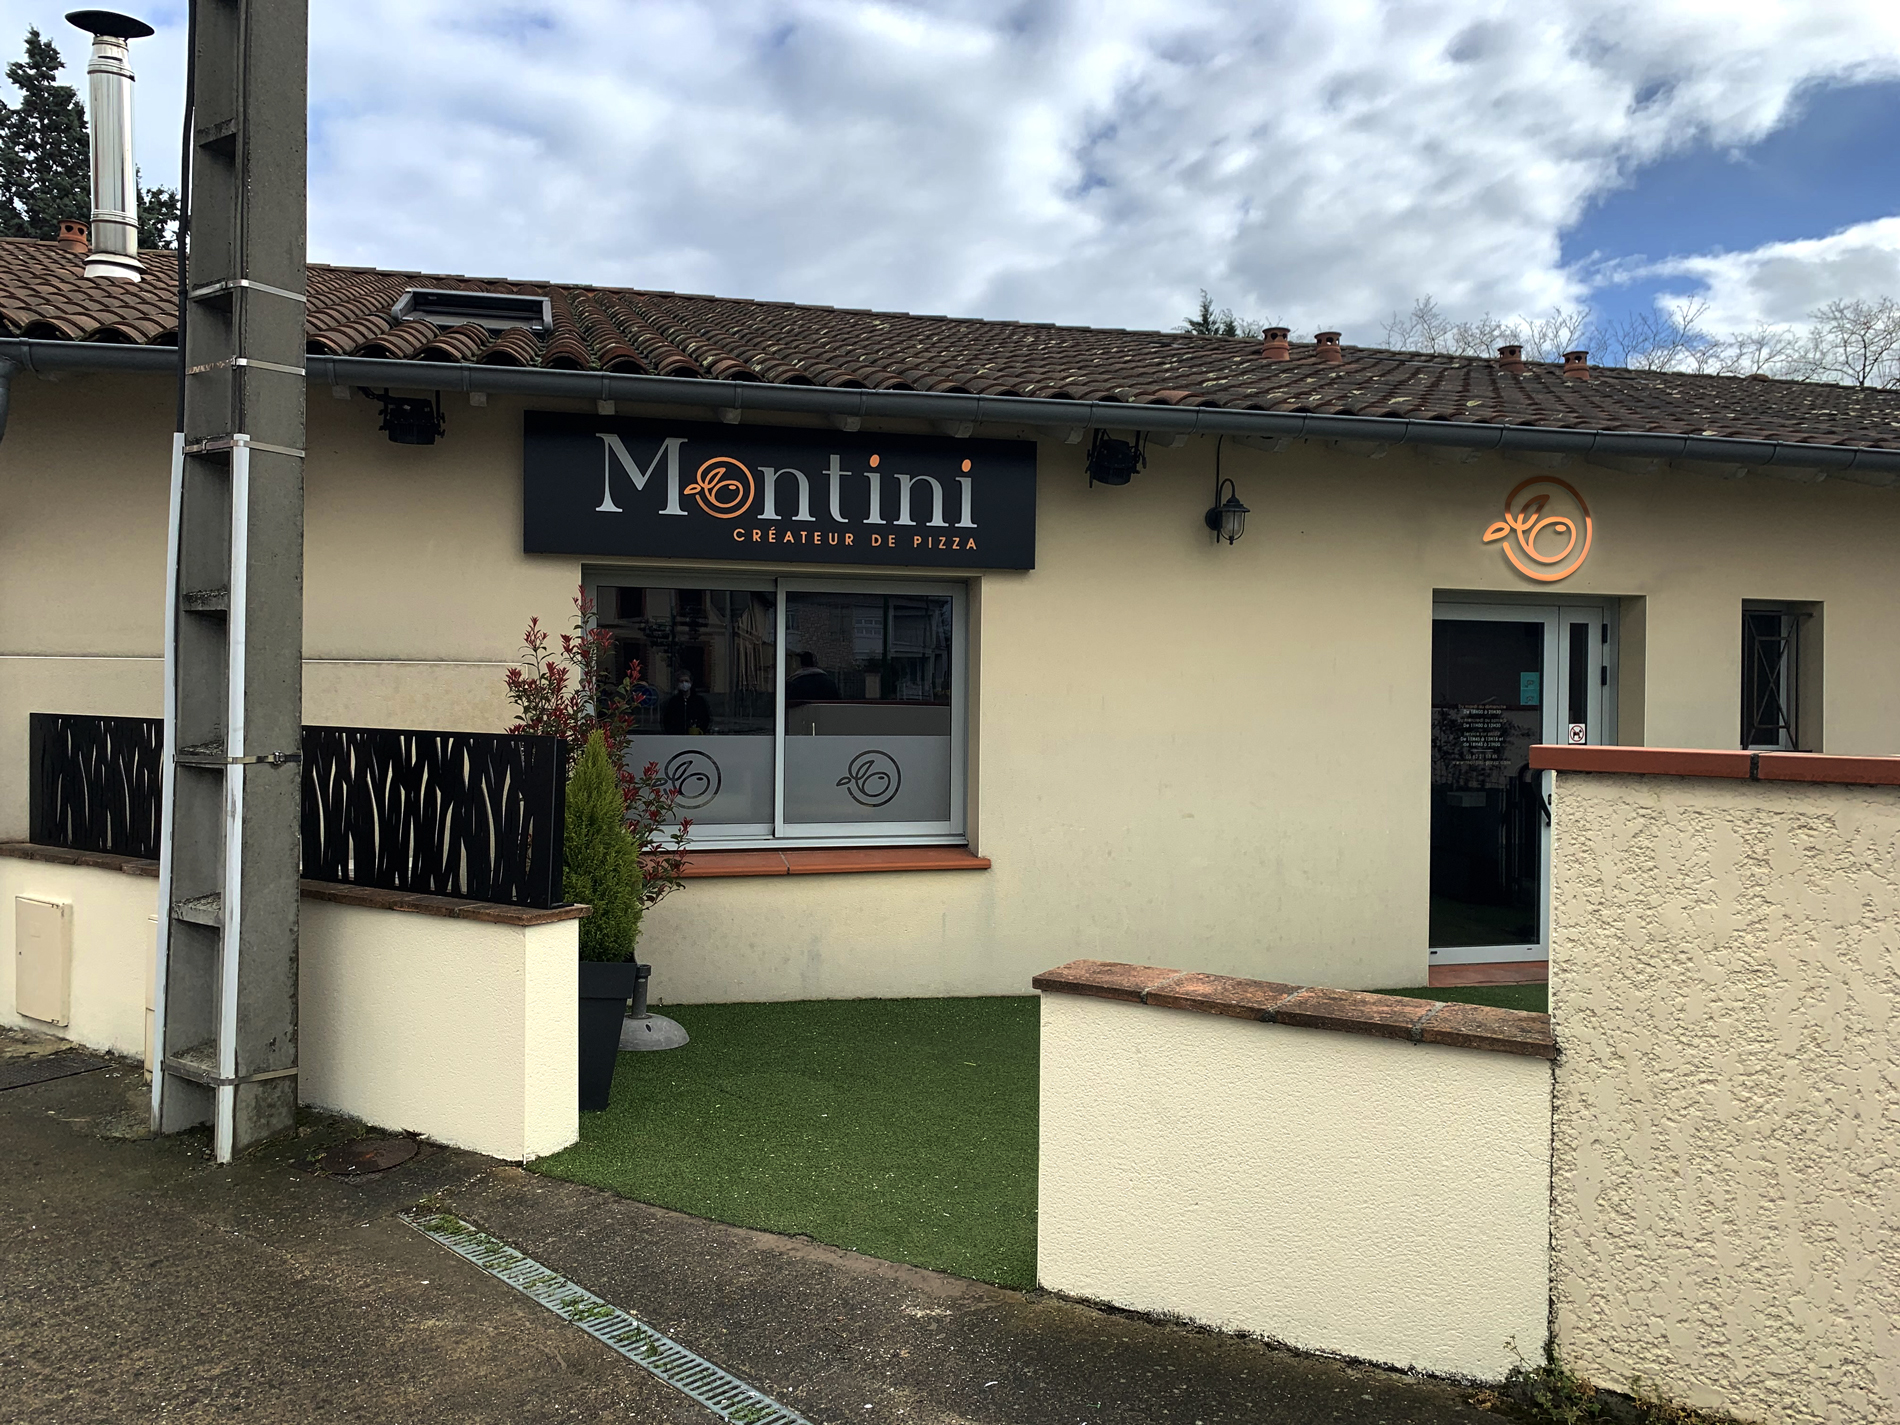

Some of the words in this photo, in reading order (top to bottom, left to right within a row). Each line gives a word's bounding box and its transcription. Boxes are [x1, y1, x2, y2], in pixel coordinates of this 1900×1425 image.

[733, 526, 854, 546] CRÉATEUR
[871, 534, 896, 547] DE
[913, 536, 977, 550] PIZZA
